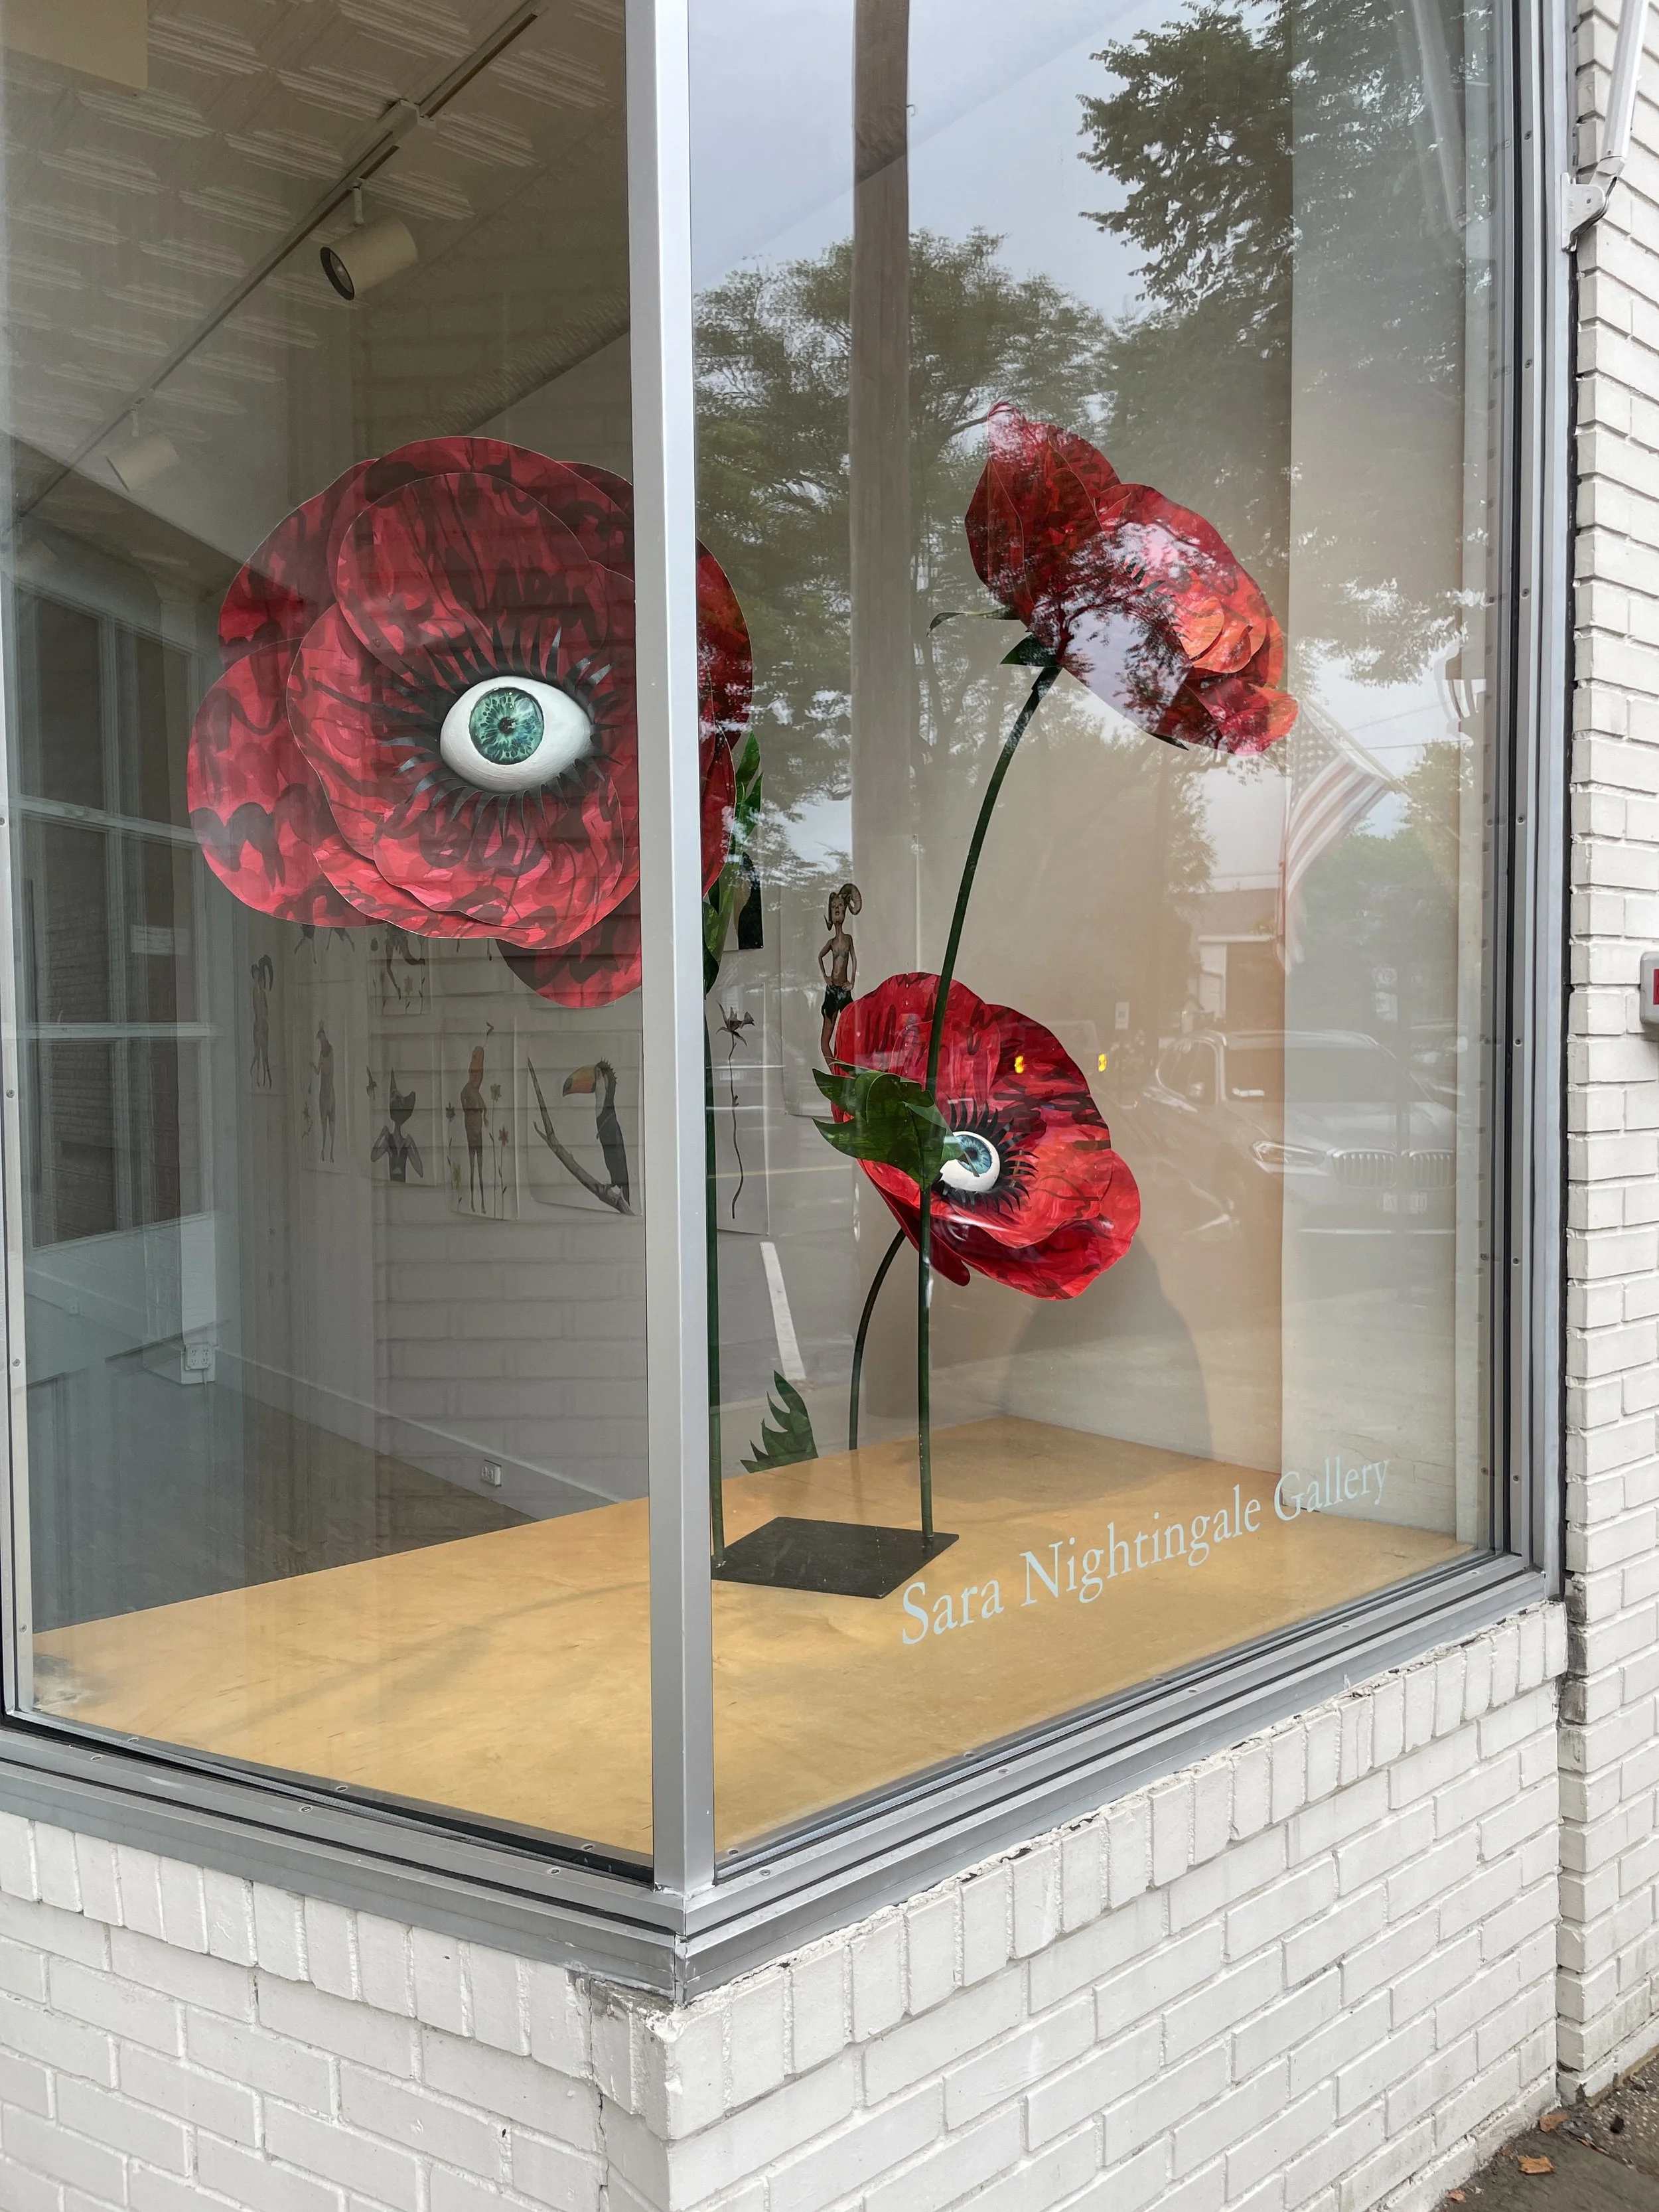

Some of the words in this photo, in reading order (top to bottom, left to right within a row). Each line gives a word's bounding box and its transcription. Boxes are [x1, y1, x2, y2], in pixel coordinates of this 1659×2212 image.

[902, 1580, 1004, 1645] Sara
[1019, 1484, 1262, 1607] Nightingale
[1273, 1456, 1390, 1521] Gallery
